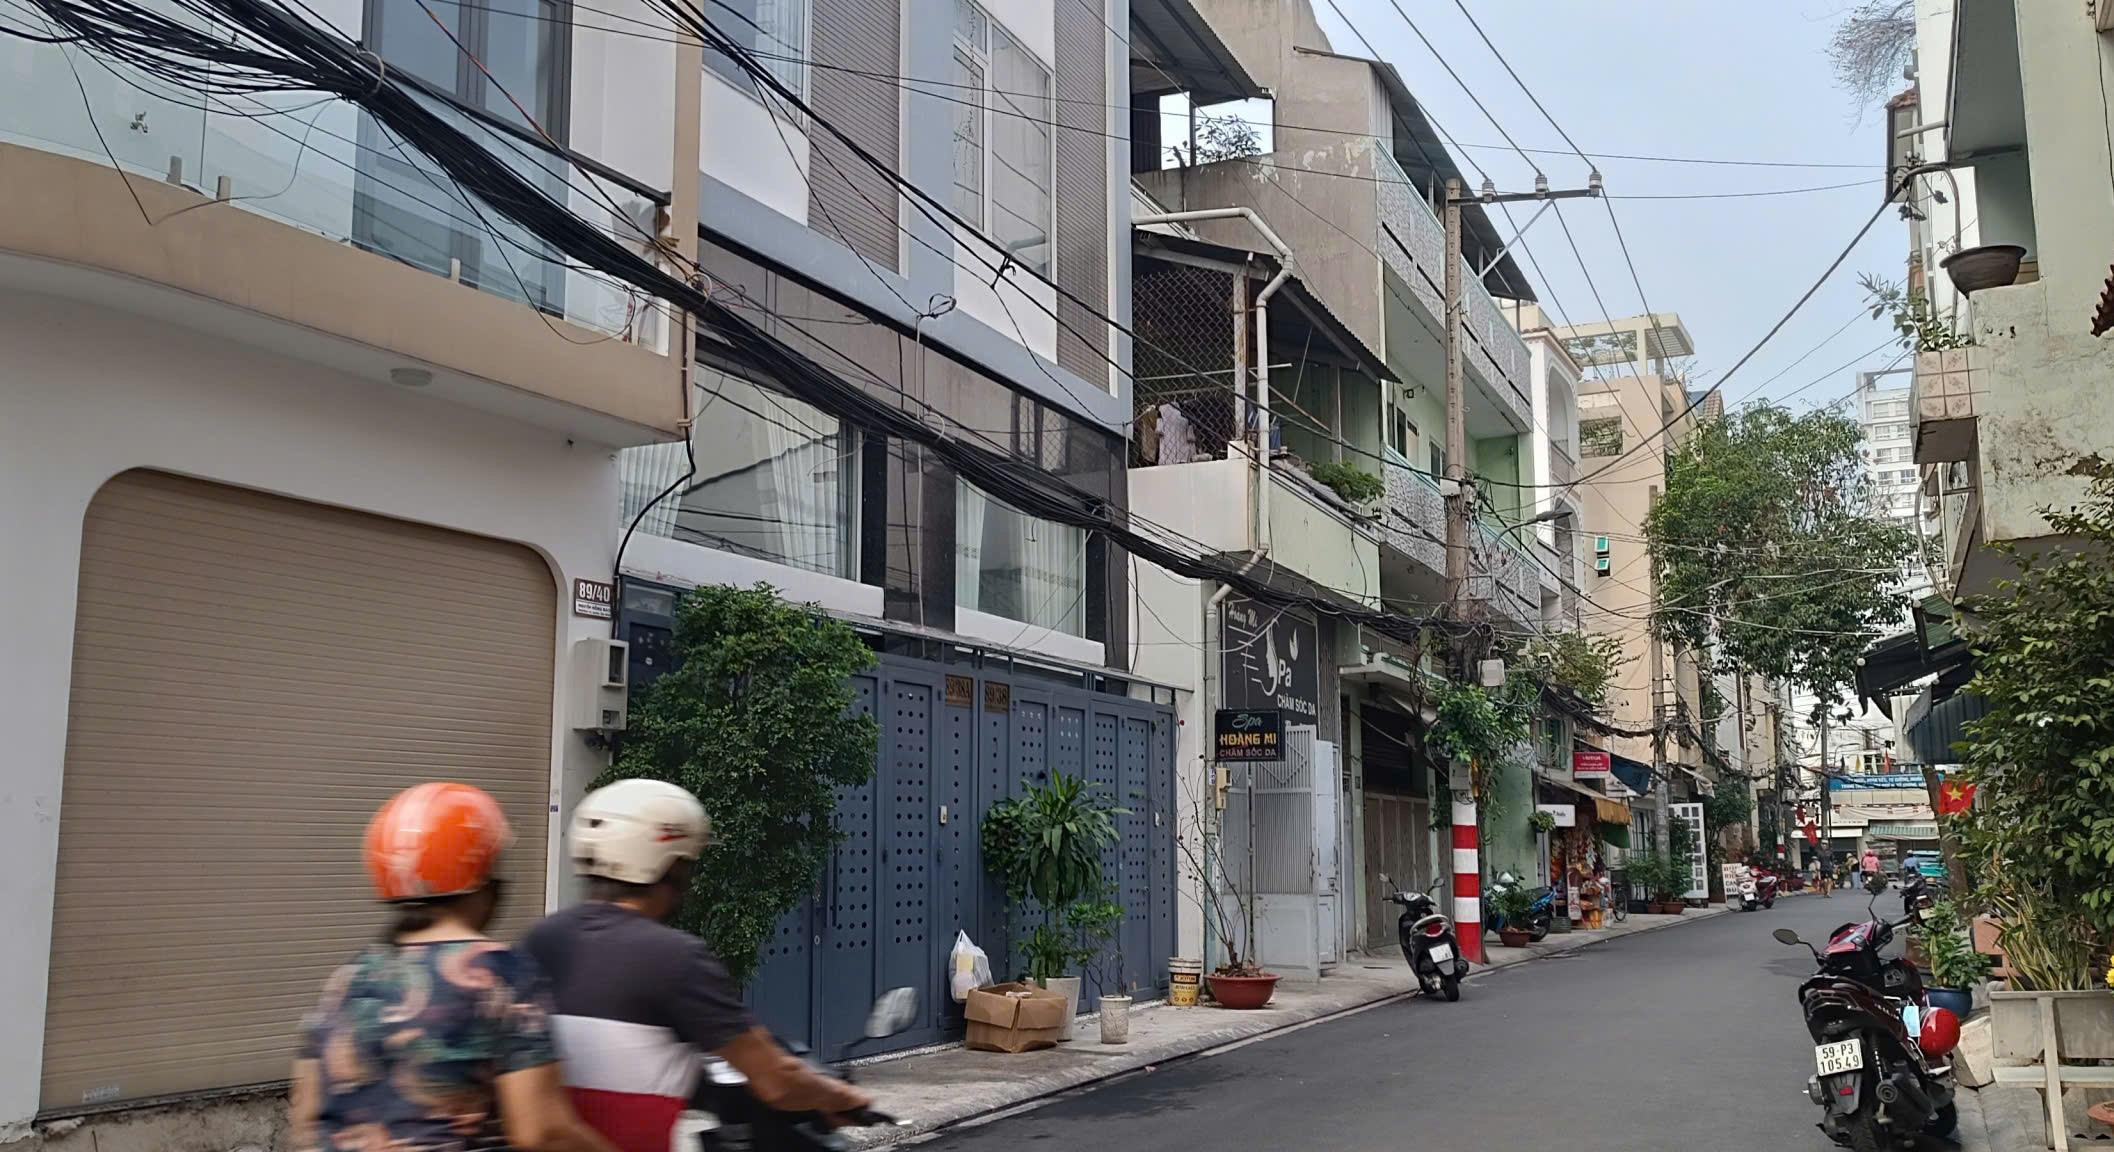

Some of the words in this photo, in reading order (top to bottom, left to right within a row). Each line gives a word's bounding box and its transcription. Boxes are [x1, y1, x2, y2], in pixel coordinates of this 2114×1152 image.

[579, 581, 611, 603] 89/40
[1295, 697, 1308, 714] SÓC
[1308, 702, 1317, 716] DA
[1231, 713, 1263, 731] Spa
[1219, 731, 1261, 746] HOÀNG
[1264, 732, 1277, 745] MI
[1219, 747, 1244, 757] CHĂM
[1245, 746, 1263, 757] SÓC
[1264, 749, 1277, 757] DA
[1820, 1054, 1860, 1074] 105.49
